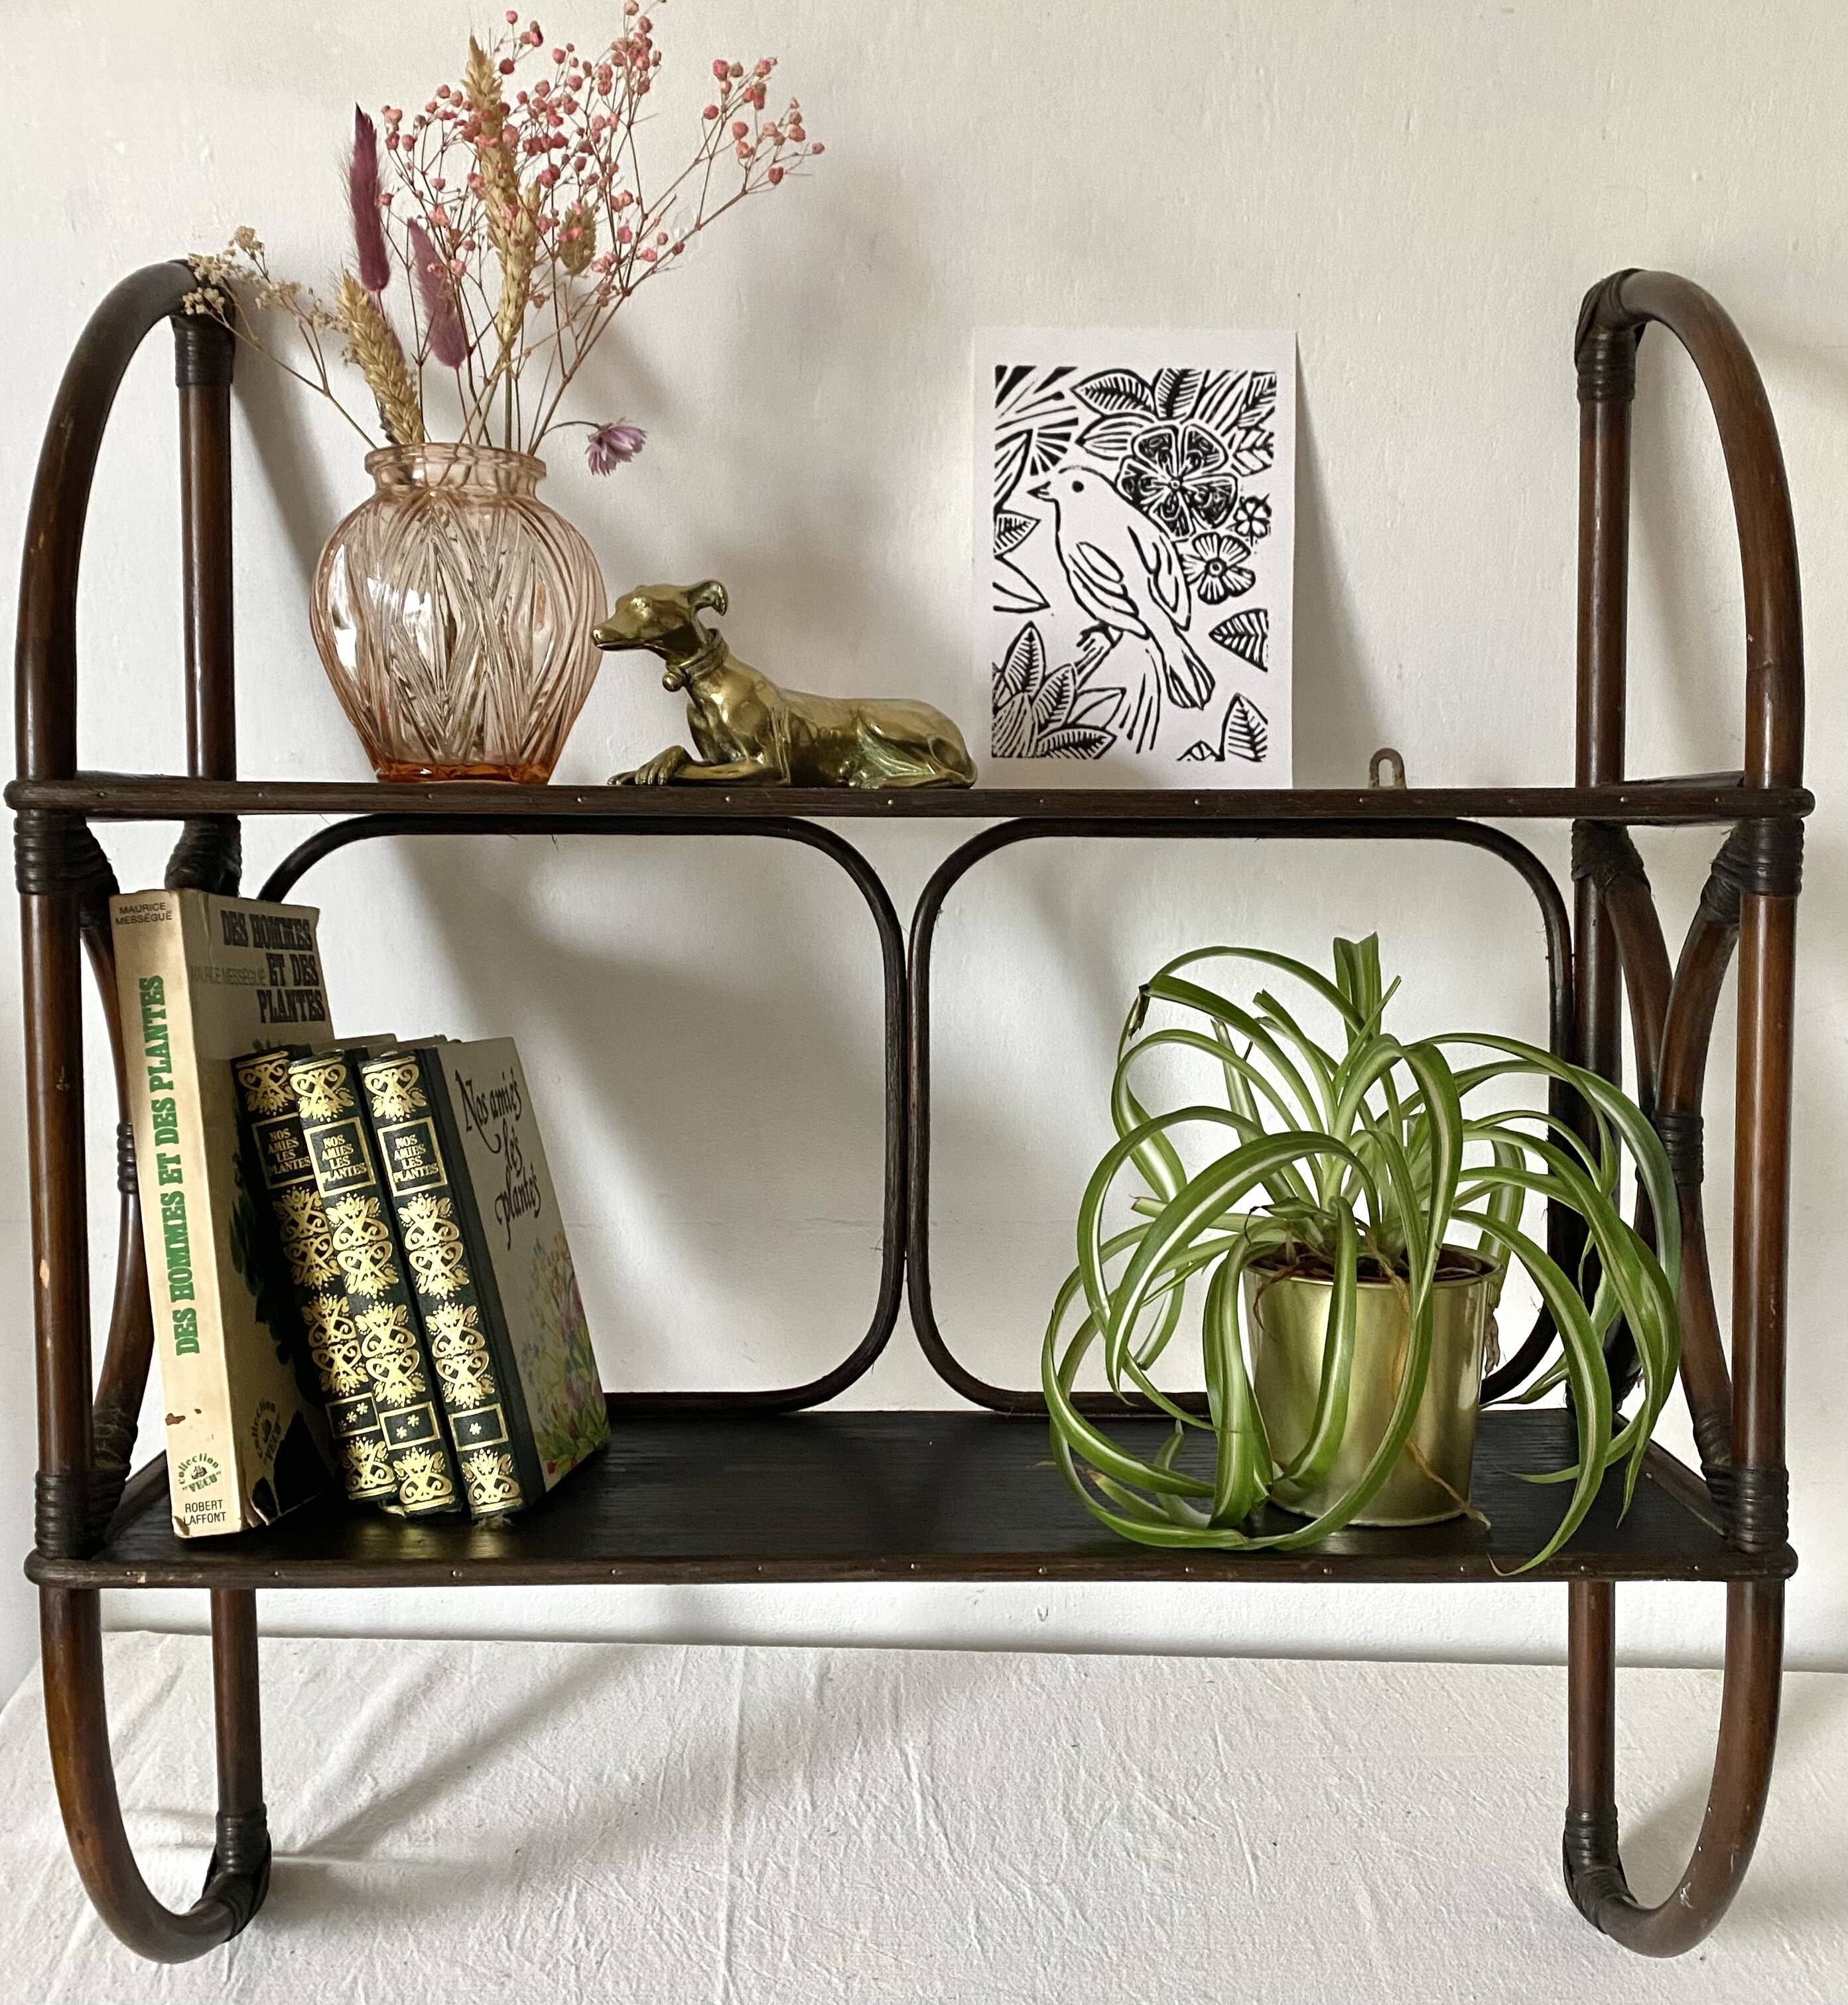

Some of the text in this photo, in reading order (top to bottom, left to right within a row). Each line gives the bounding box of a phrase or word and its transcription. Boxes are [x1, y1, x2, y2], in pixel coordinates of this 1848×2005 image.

[119, 902, 166, 914] MAURICE
[220, 910, 249, 947] DES
[266, 952, 319, 986] ET DES
[257, 989, 326, 1023] PLANTES
[455, 1067, 521, 1153] Nos amies
[269, 1128, 291, 1142] NOS
[323, 1134, 345, 1149] NOS
[395, 1134, 417, 1149] NOS
[268, 1137, 299, 1155] AMIES
[322, 1143, 354, 1161] AMIES
[394, 1143, 426, 1161] AMIES
[503, 1118, 523, 1178] les
[276, 1149, 296, 1162] LES
[329, 1155, 350, 1170] LES
[401, 1155, 423, 1170] LES
[139, 975, 200, 1356] DES HOMMES ET DES PLANTES
[320, 1162, 367, 1183] PLANTES
[393, 1163, 438, 1183] PLANTES
[495, 1162, 541, 1251] plantes
[185, 1500, 223, 1513] ROBERT
[184, 1512, 226, 1525] LAFFONT
